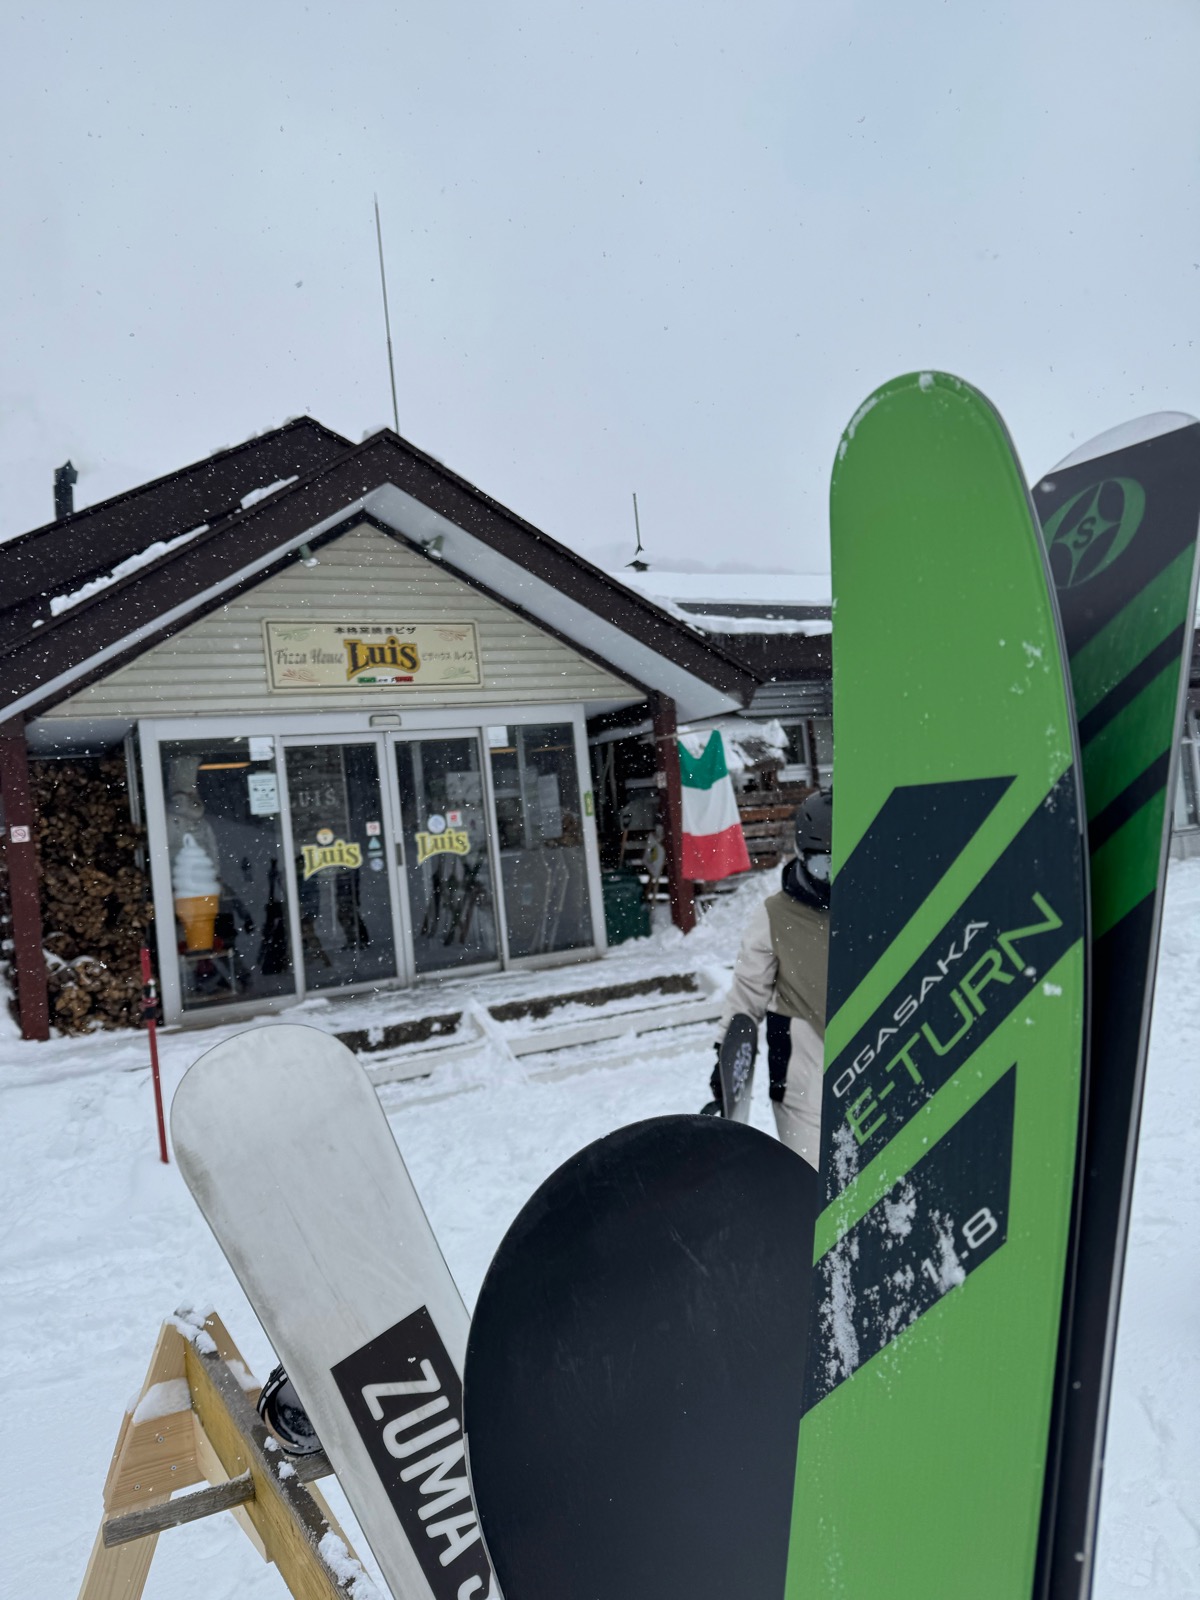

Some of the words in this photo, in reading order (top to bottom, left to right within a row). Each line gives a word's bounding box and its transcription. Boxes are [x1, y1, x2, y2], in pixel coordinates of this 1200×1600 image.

[274, 647, 307, 665] Pizza
[346, 637, 418, 675] Luis
[304, 841, 361, 875] Luis
[416, 830, 469, 862] Luis
[832, 921, 989, 1098] OGASAKA
[845, 891, 1063, 1146] E-TURN
[361, 1358, 481, 1567] ZUMA
